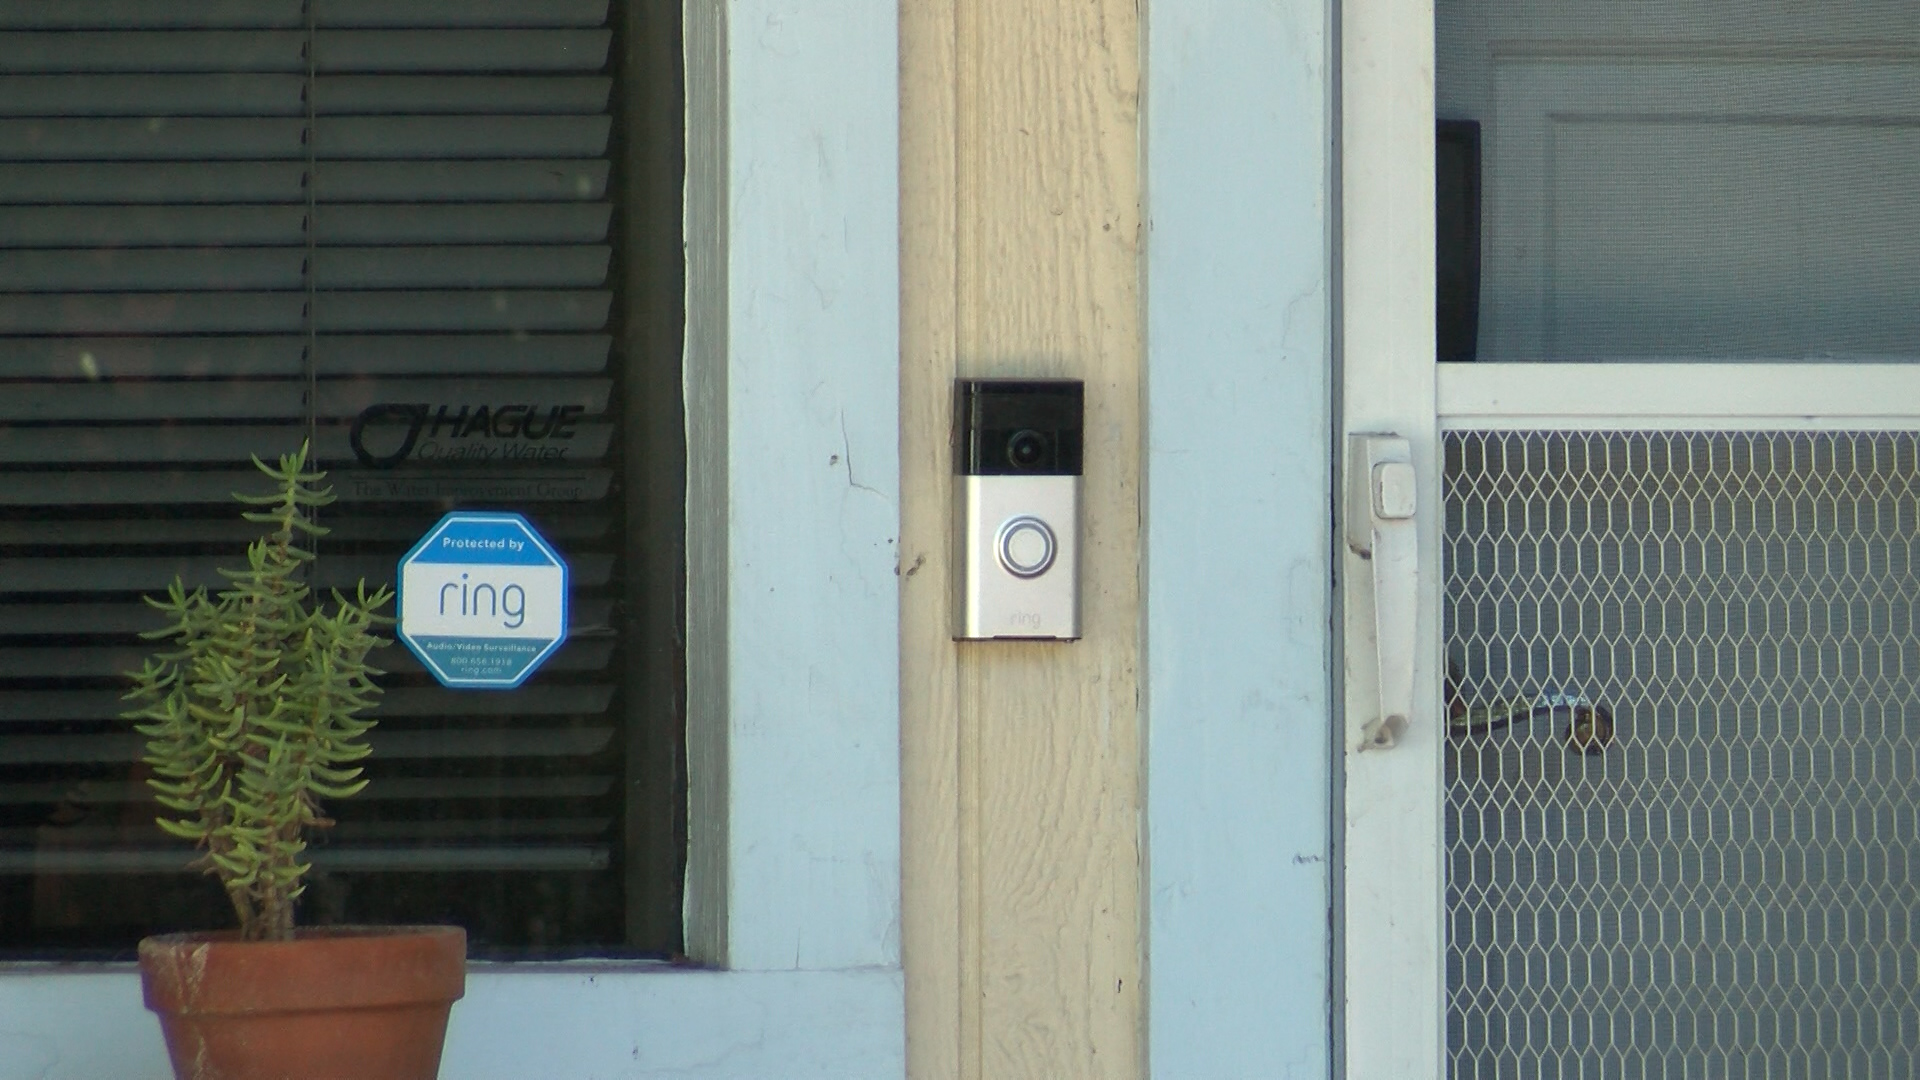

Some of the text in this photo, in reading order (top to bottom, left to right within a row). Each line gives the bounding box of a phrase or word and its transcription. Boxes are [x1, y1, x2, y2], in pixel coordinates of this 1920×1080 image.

[430, 405, 585, 439] HAGUE
[418, 442, 569, 461] Quality Water
[354, 481, 380, 497] The
[386, 481, 431, 497] Water
[536, 482, 583, 500] Group
[442, 537, 525, 551] Protected by
[439, 573, 526, 629] ring
[1010, 611, 1041, 630] ring
[483, 643, 537, 653] Surveillance
